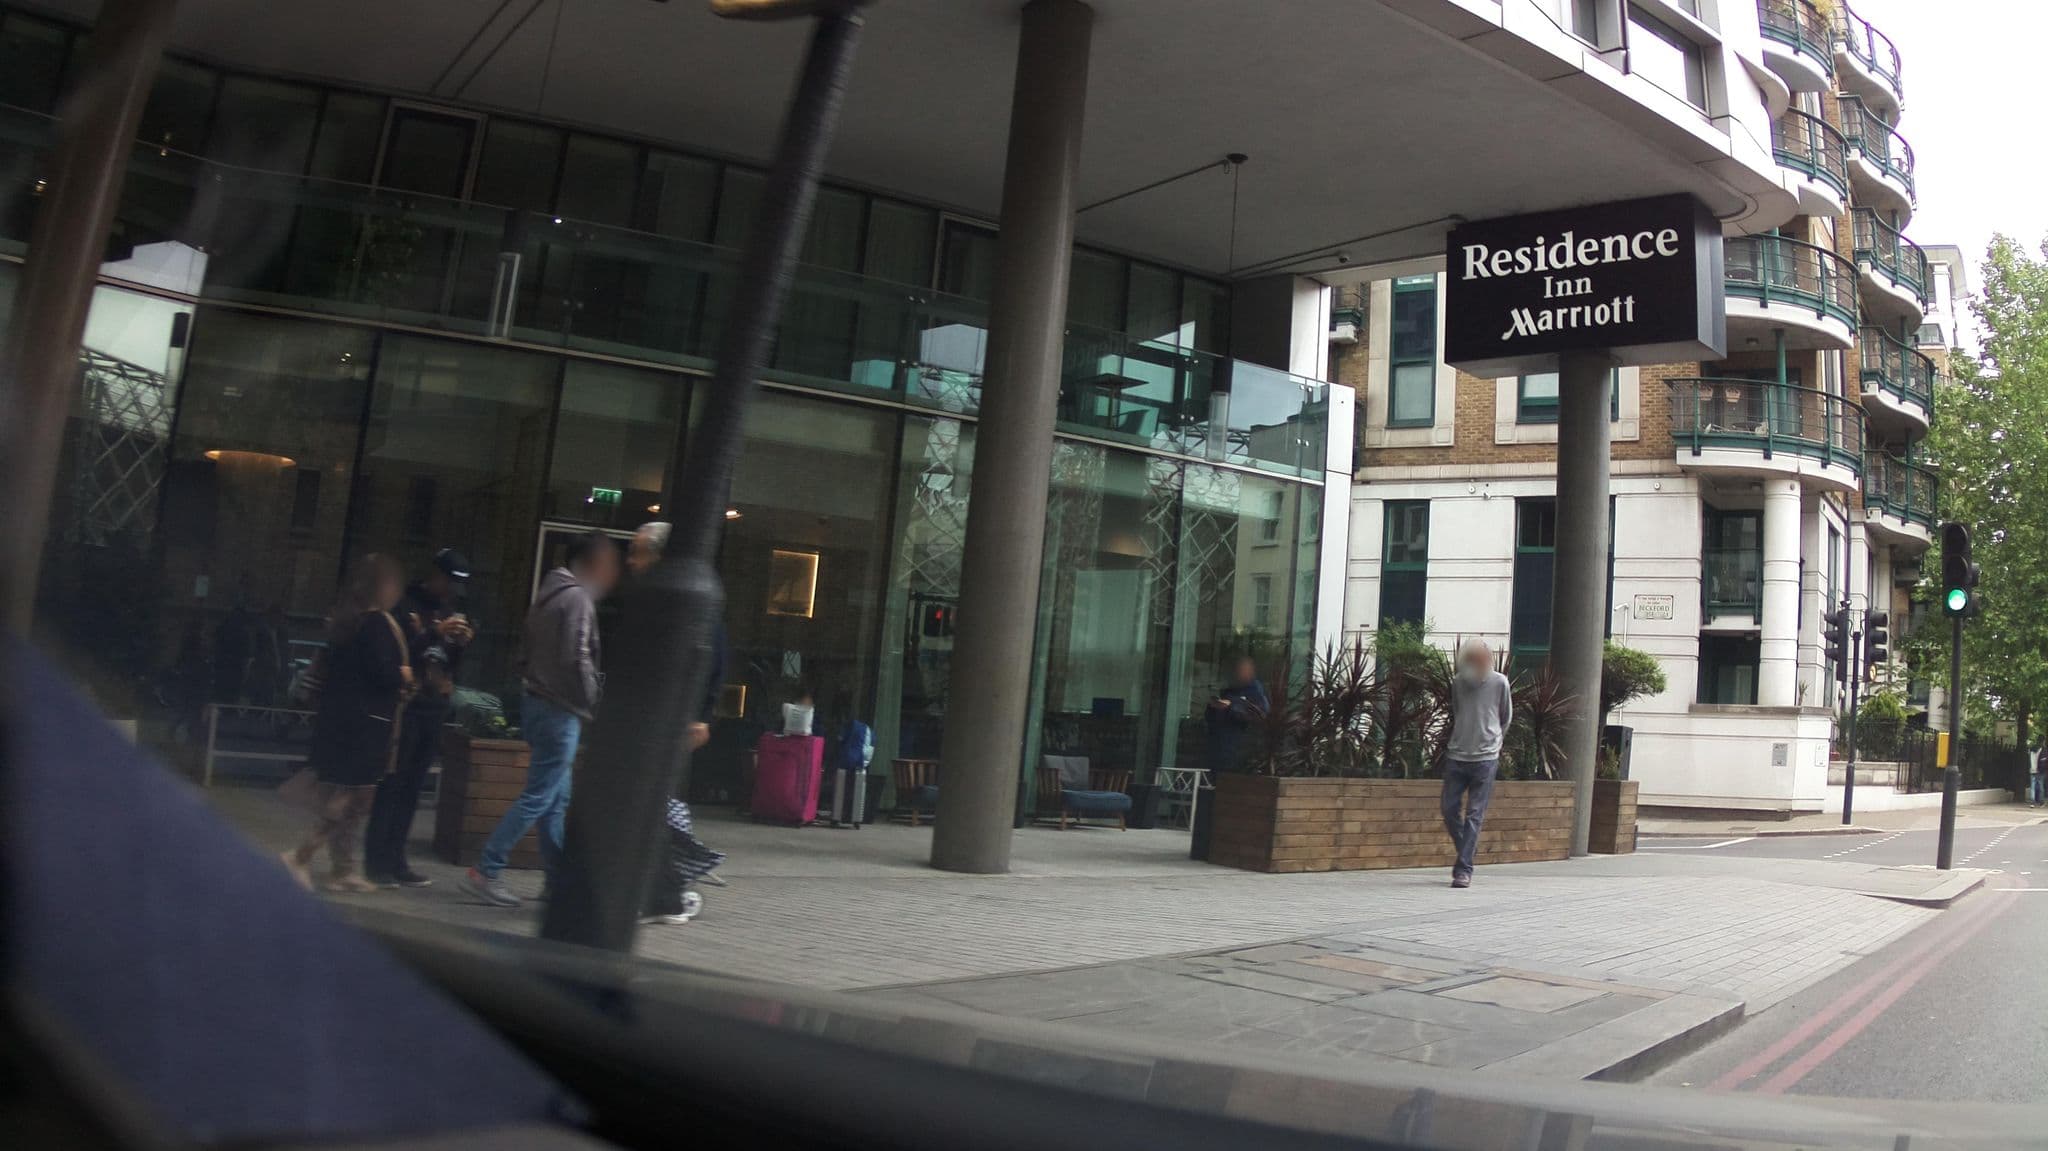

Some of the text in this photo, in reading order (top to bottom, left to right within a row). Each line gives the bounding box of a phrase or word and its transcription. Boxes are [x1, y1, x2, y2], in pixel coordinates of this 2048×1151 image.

[1461, 227, 1680, 281] Residence
[1543, 275, 1593, 299] Inn
[1501, 294, 1636, 341] Marriott
